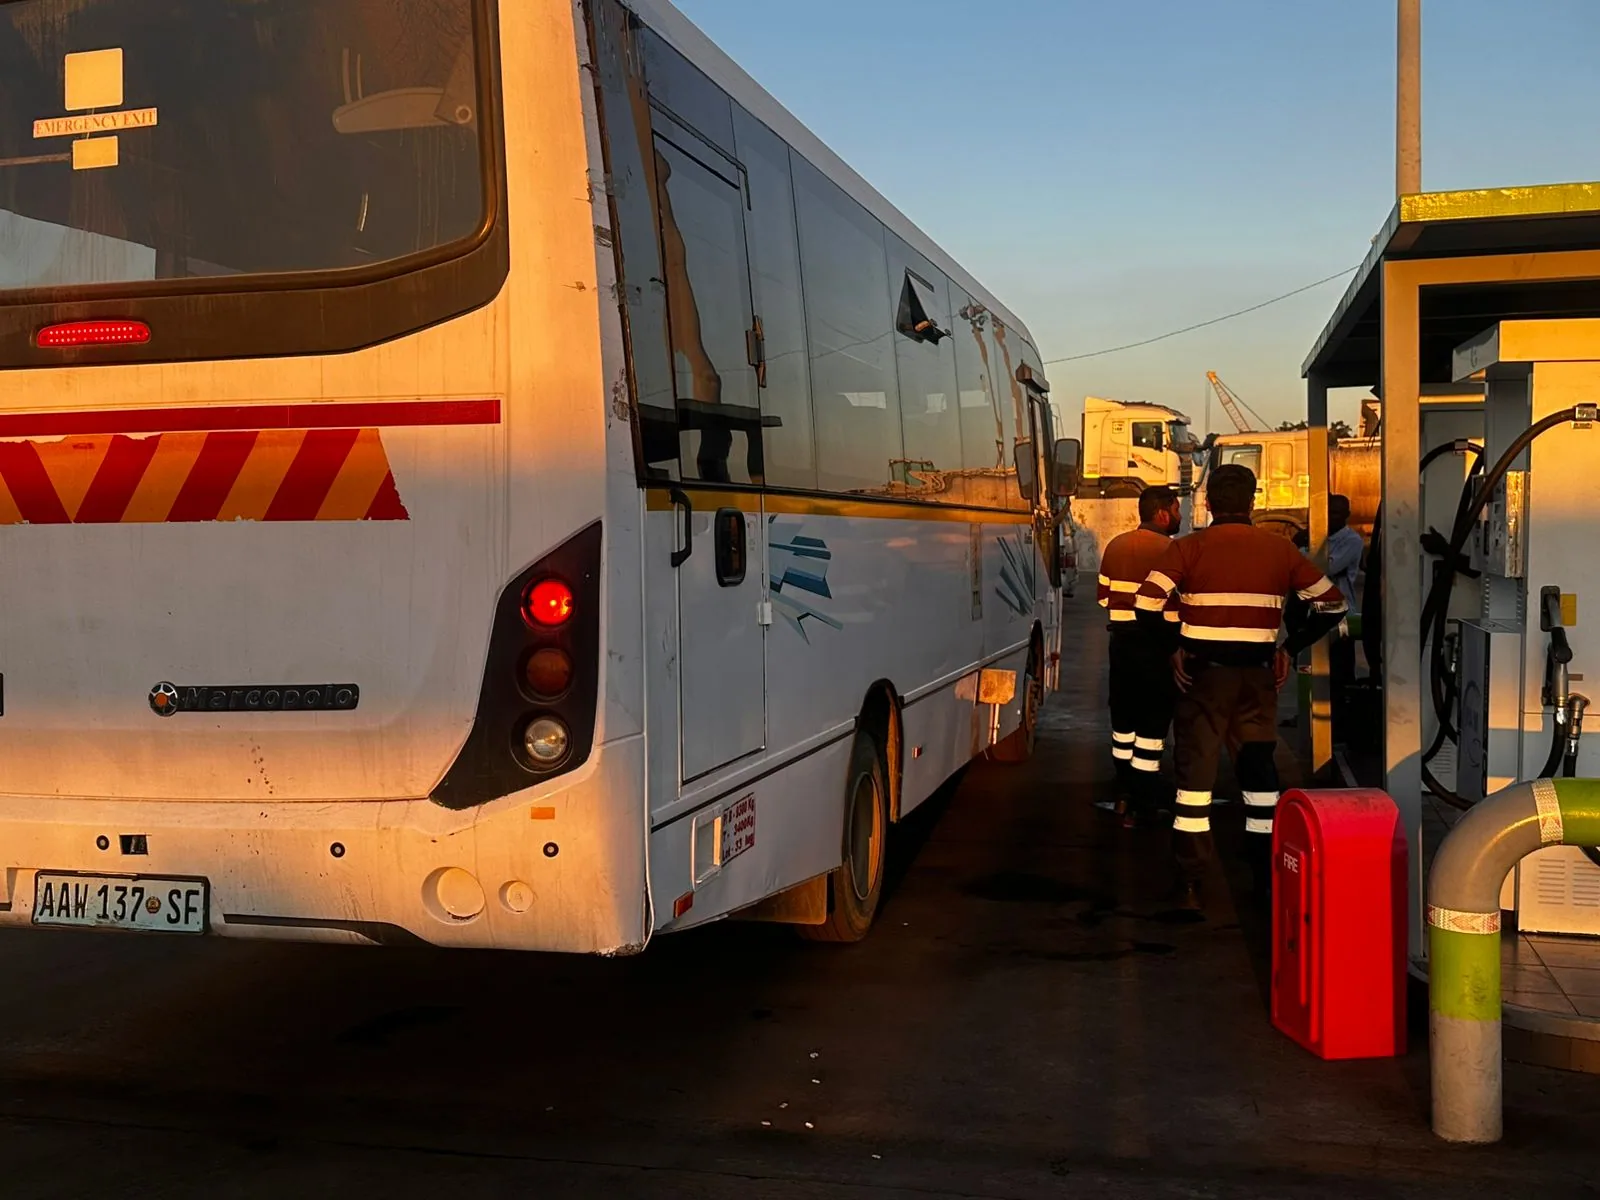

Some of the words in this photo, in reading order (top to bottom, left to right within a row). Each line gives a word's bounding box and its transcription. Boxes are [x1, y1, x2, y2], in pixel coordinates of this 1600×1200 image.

[36, 115, 120, 135] EMERGENCY
[123, 111, 155, 126] EXIT
[184, 686, 353, 709] Marcopolo
[1284, 852, 1298, 873] FIRE
[38, 882, 89, 919] AAW
[96, 884, 145, 922] 137
[166, 889, 200, 925] SF
